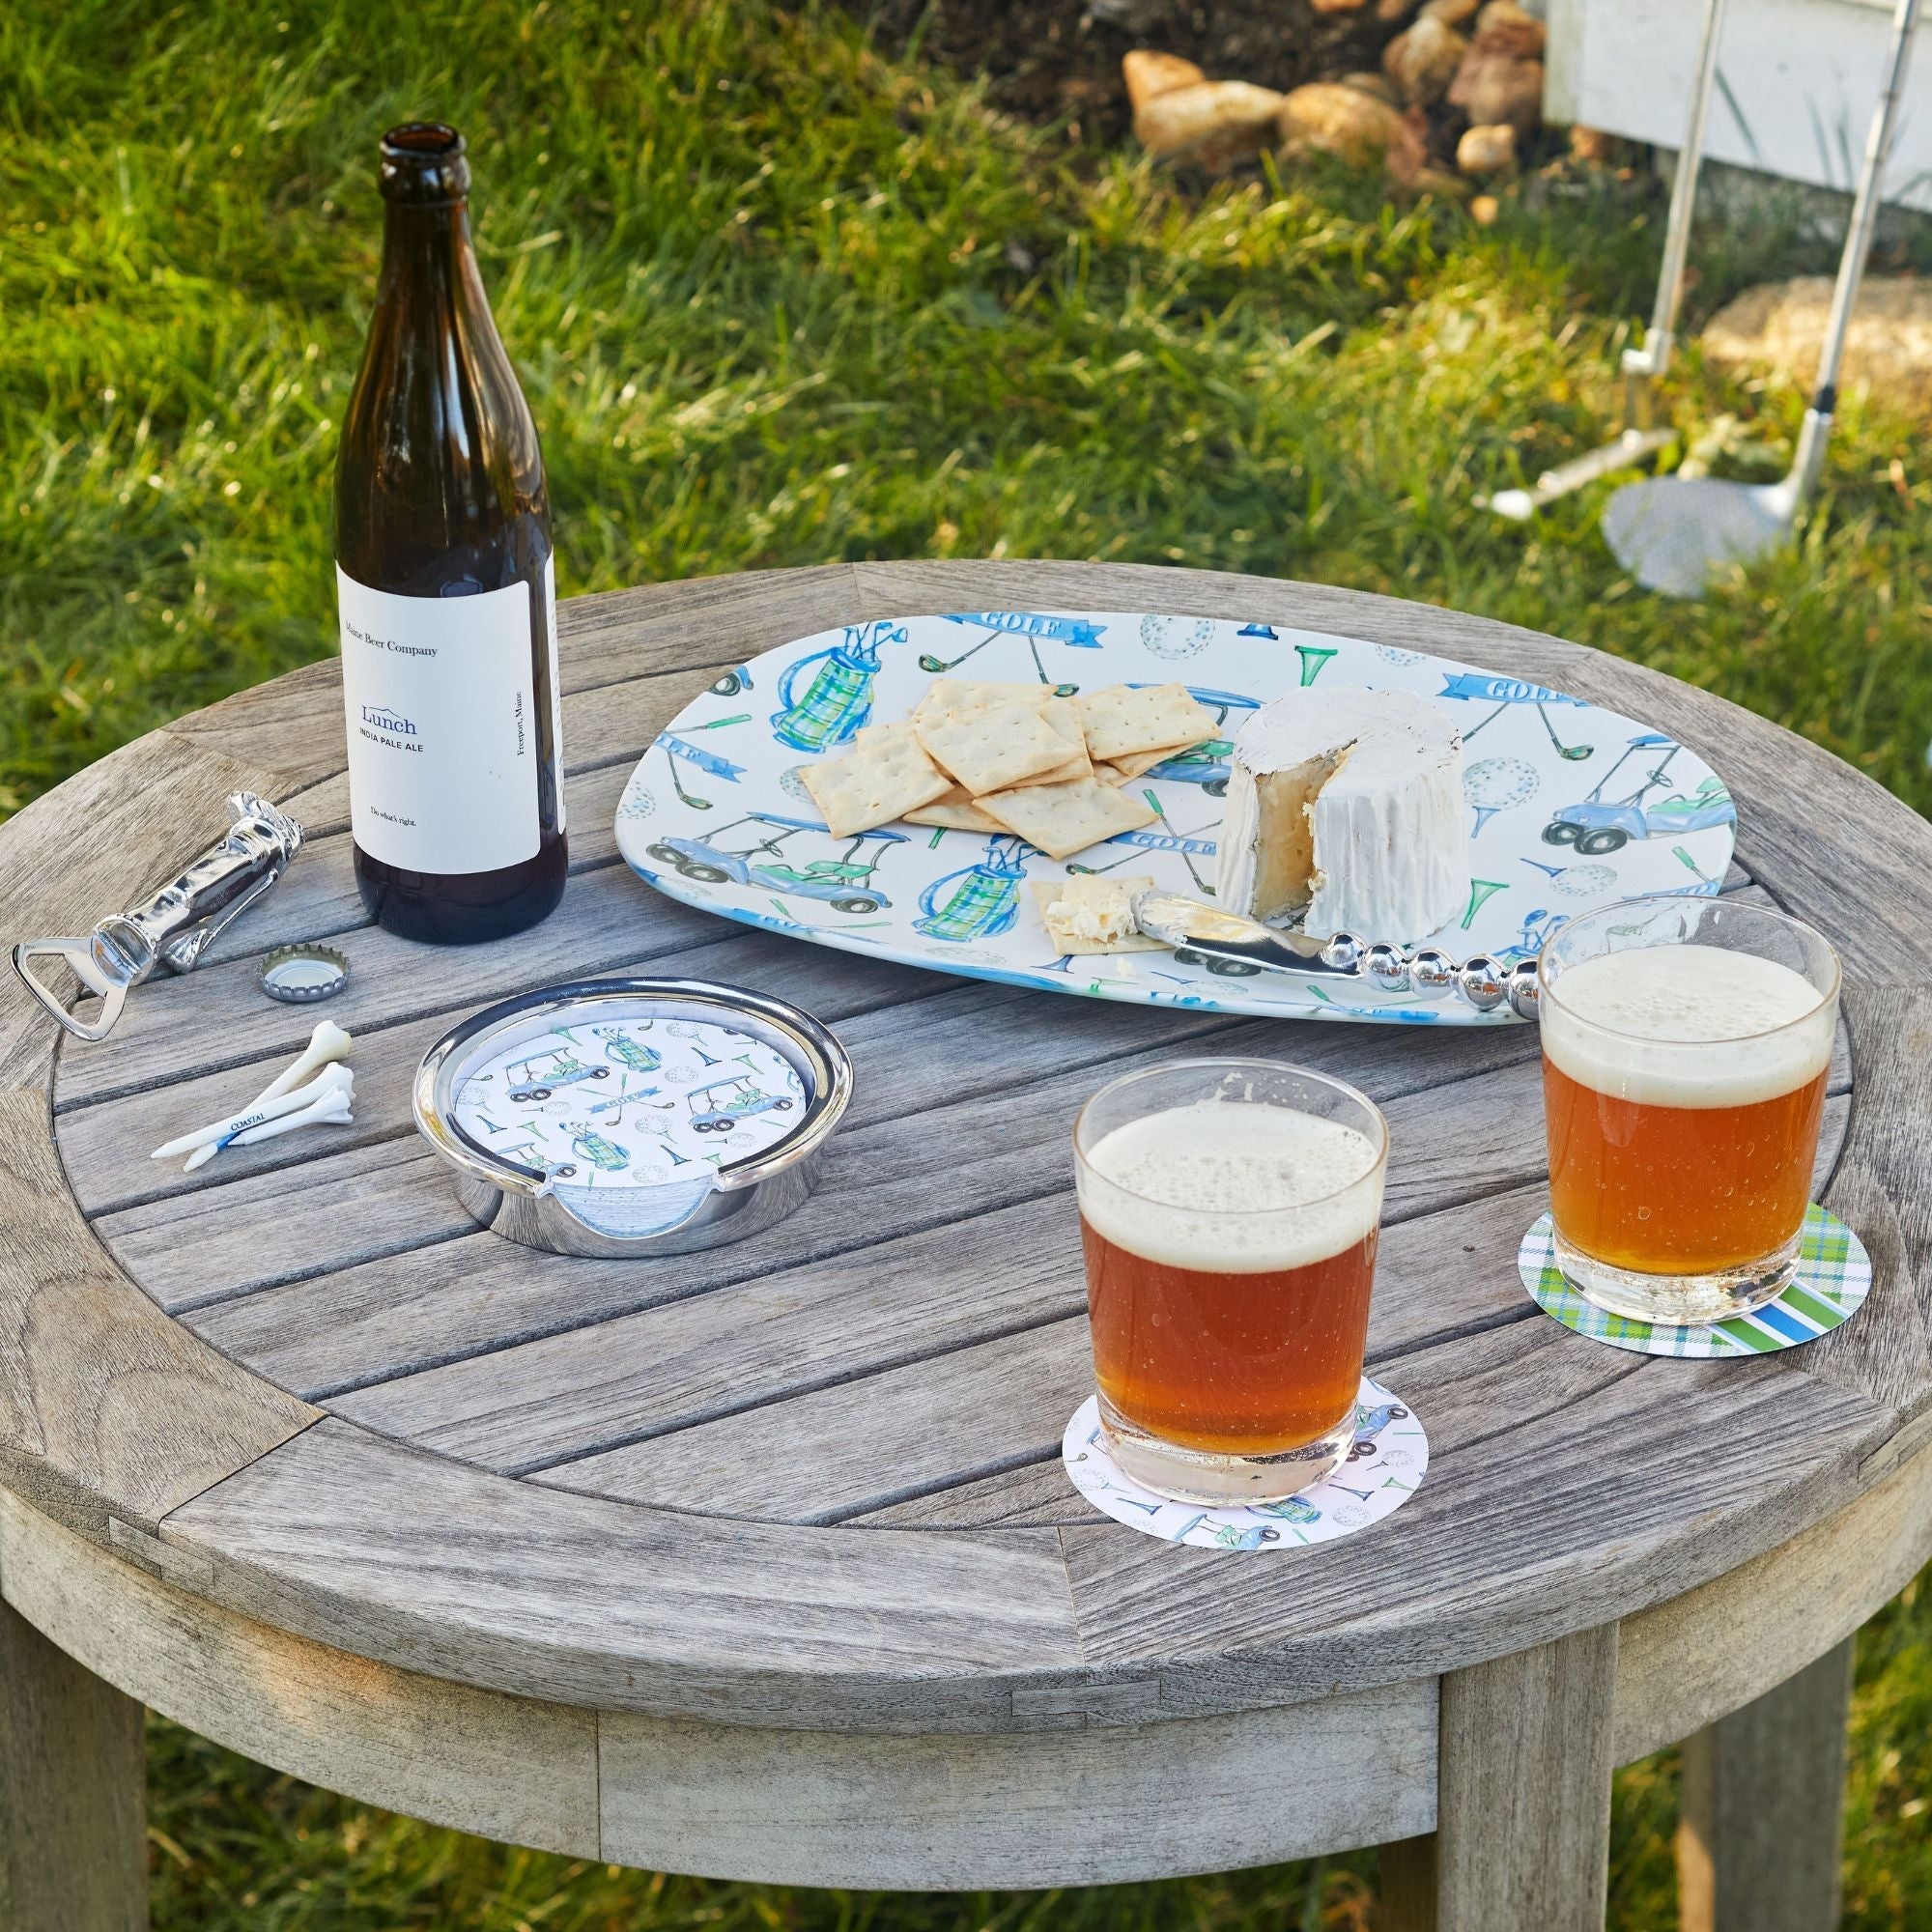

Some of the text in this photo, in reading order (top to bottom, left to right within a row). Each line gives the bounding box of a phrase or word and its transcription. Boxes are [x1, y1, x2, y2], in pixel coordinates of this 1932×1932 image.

[981, 611, 1062, 635] GOLF
[364, 632, 385, 649] Beer
[386, 640, 439, 657] Company
[361, 705, 418, 735] Lunch
[359, 726, 425, 753] INDIA PALE ALE
[517, 718, 526, 756] Freeport,
[370, 806, 380, 816] Do
[1131, 835, 1216, 853] GOLF
[230, 1112, 266, 1131] COASTAL
